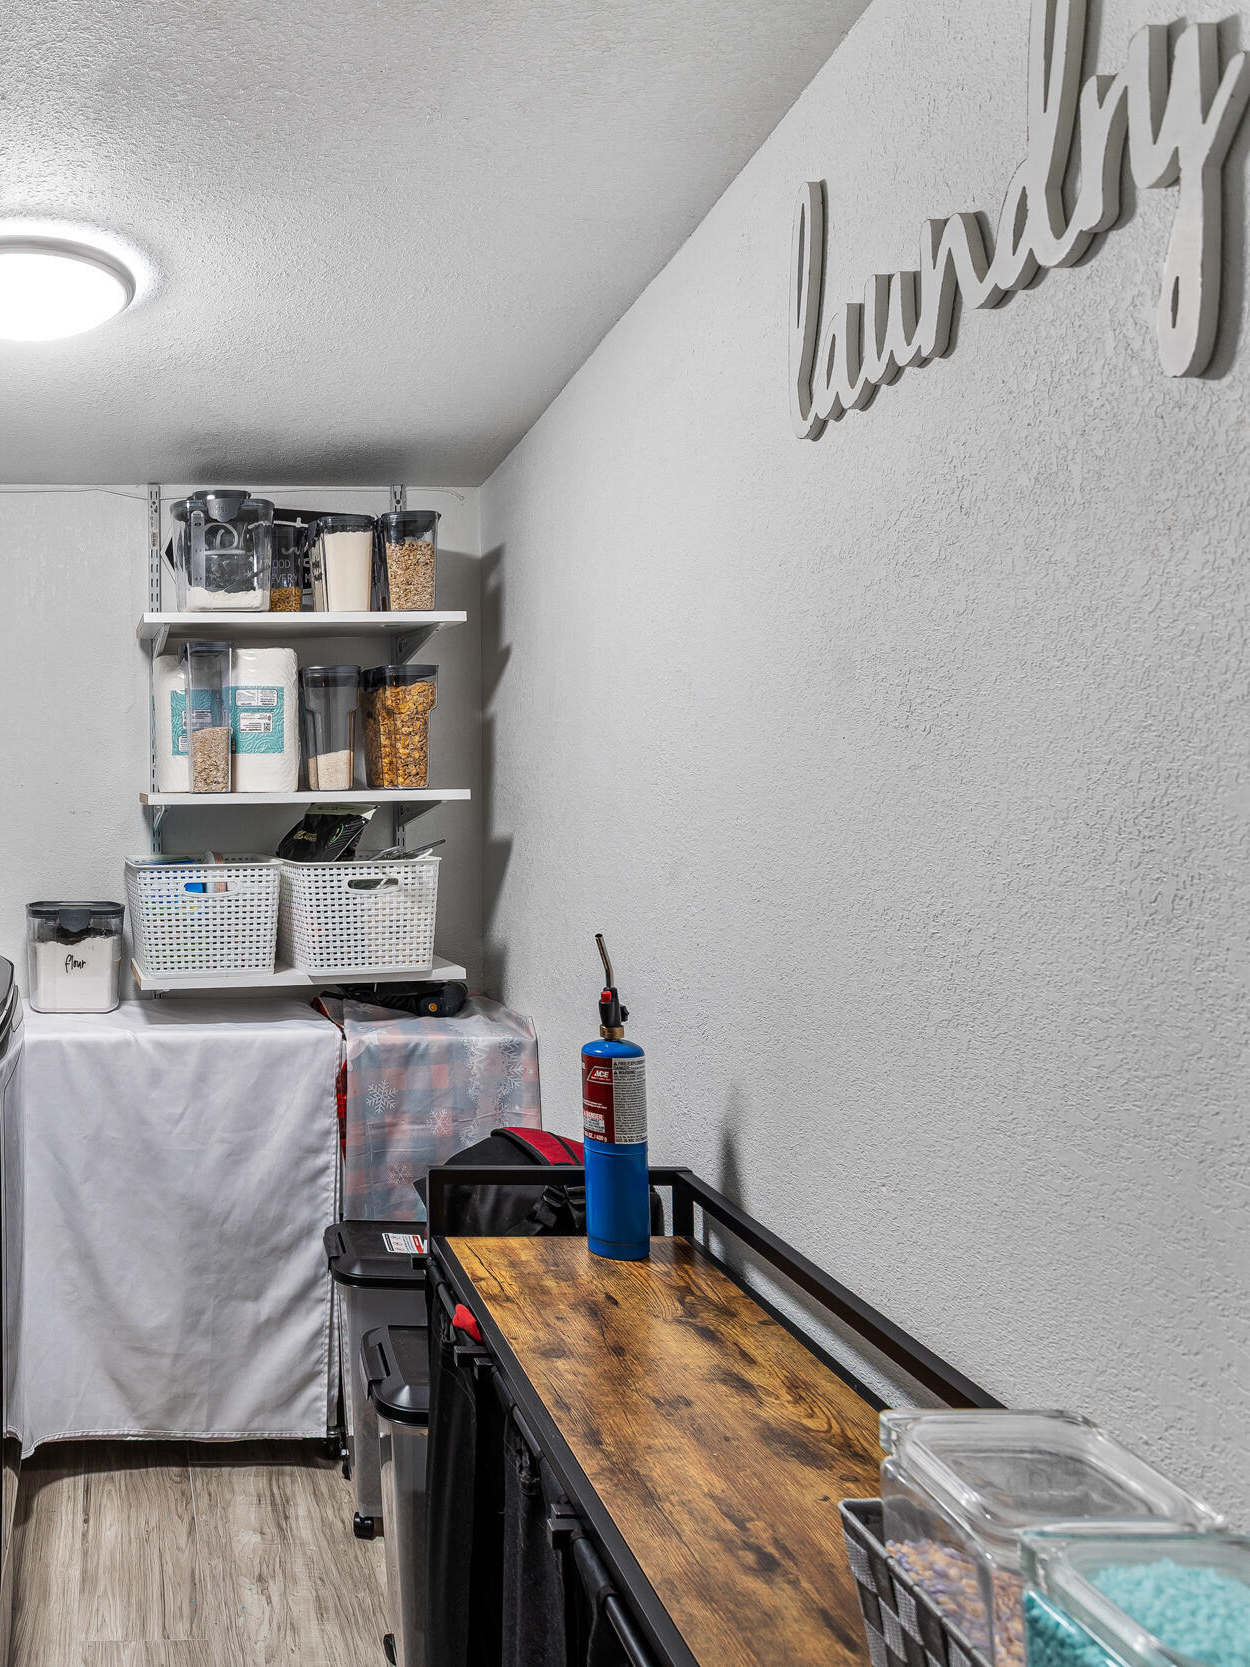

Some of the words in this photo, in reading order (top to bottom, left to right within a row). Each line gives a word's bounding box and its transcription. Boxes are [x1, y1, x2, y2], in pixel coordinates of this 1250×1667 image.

[789, 0, 1250, 440] laundry
[64, 953, 87, 974] flour
[593, 1070, 609, 1078] ACE
